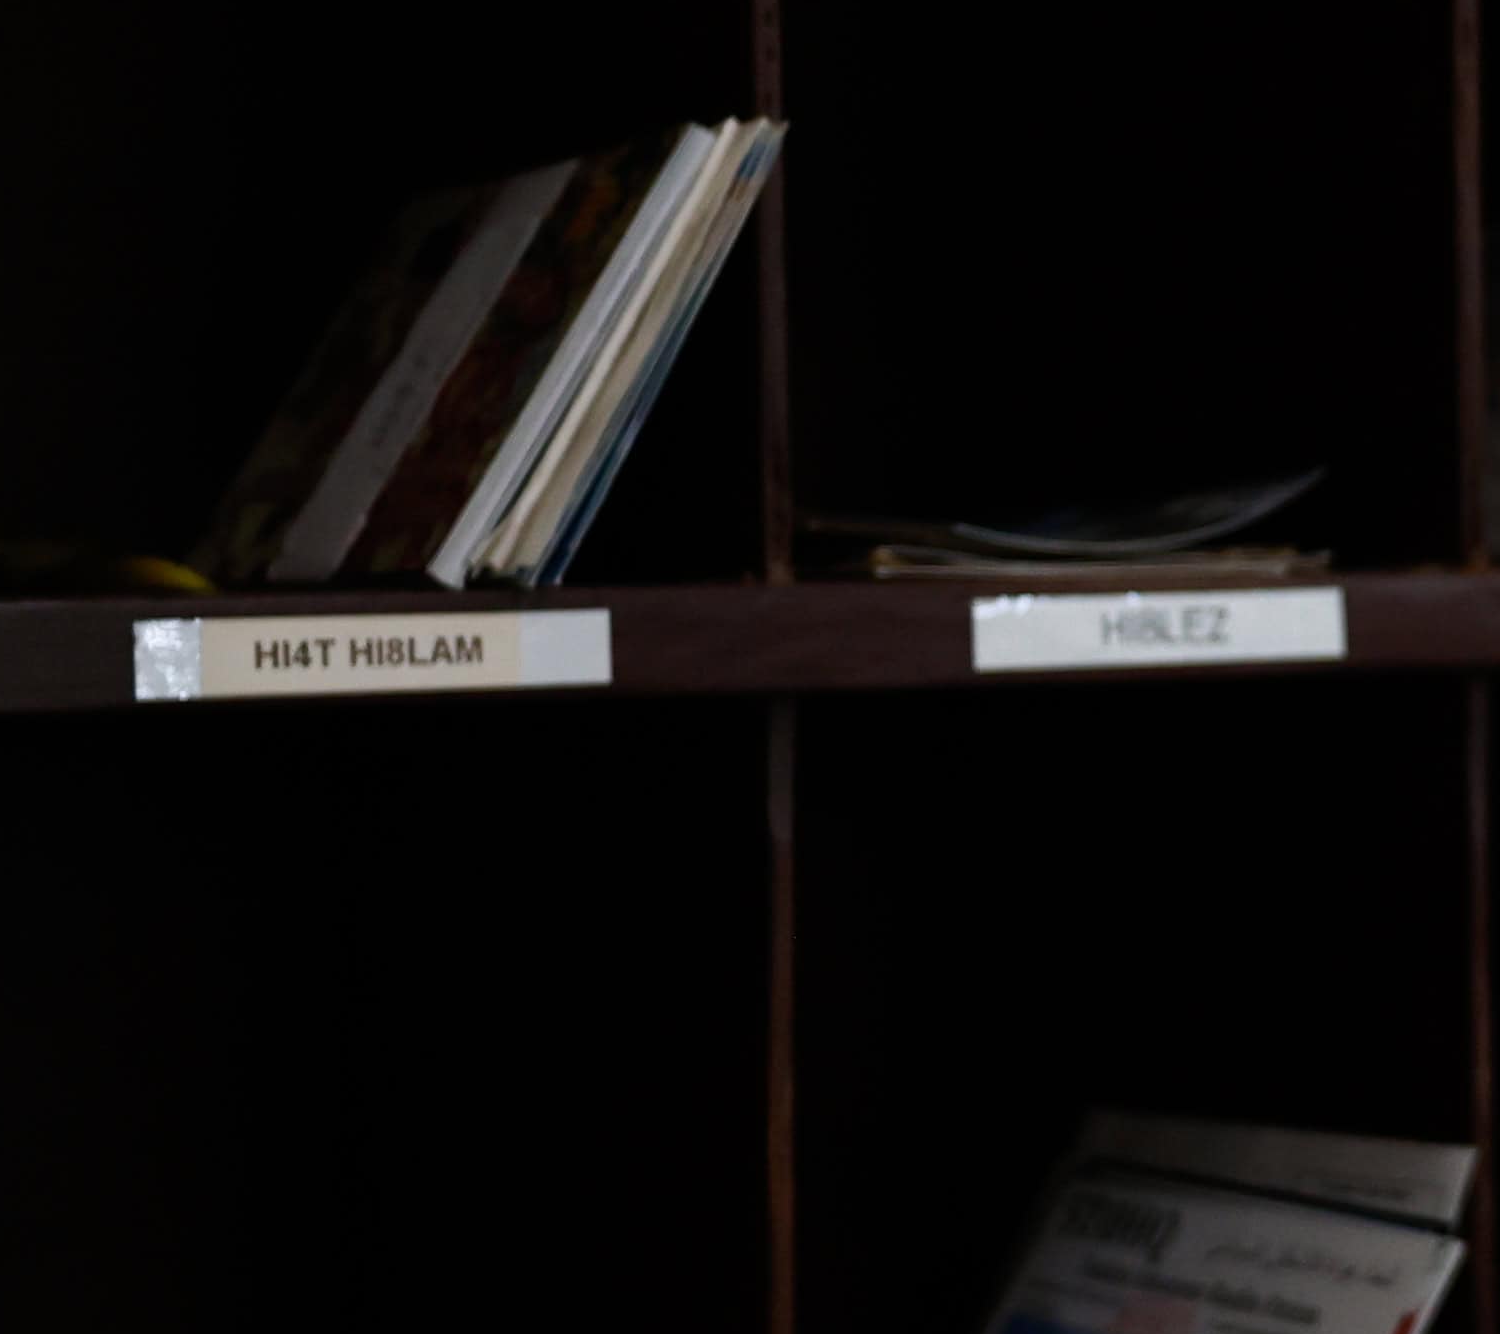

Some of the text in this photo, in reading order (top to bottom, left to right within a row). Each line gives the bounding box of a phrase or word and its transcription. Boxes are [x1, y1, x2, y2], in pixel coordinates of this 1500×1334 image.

[1100, 606, 1231, 648] HI8LEZ
[253, 633, 486, 671] HI4T HI8LAM
